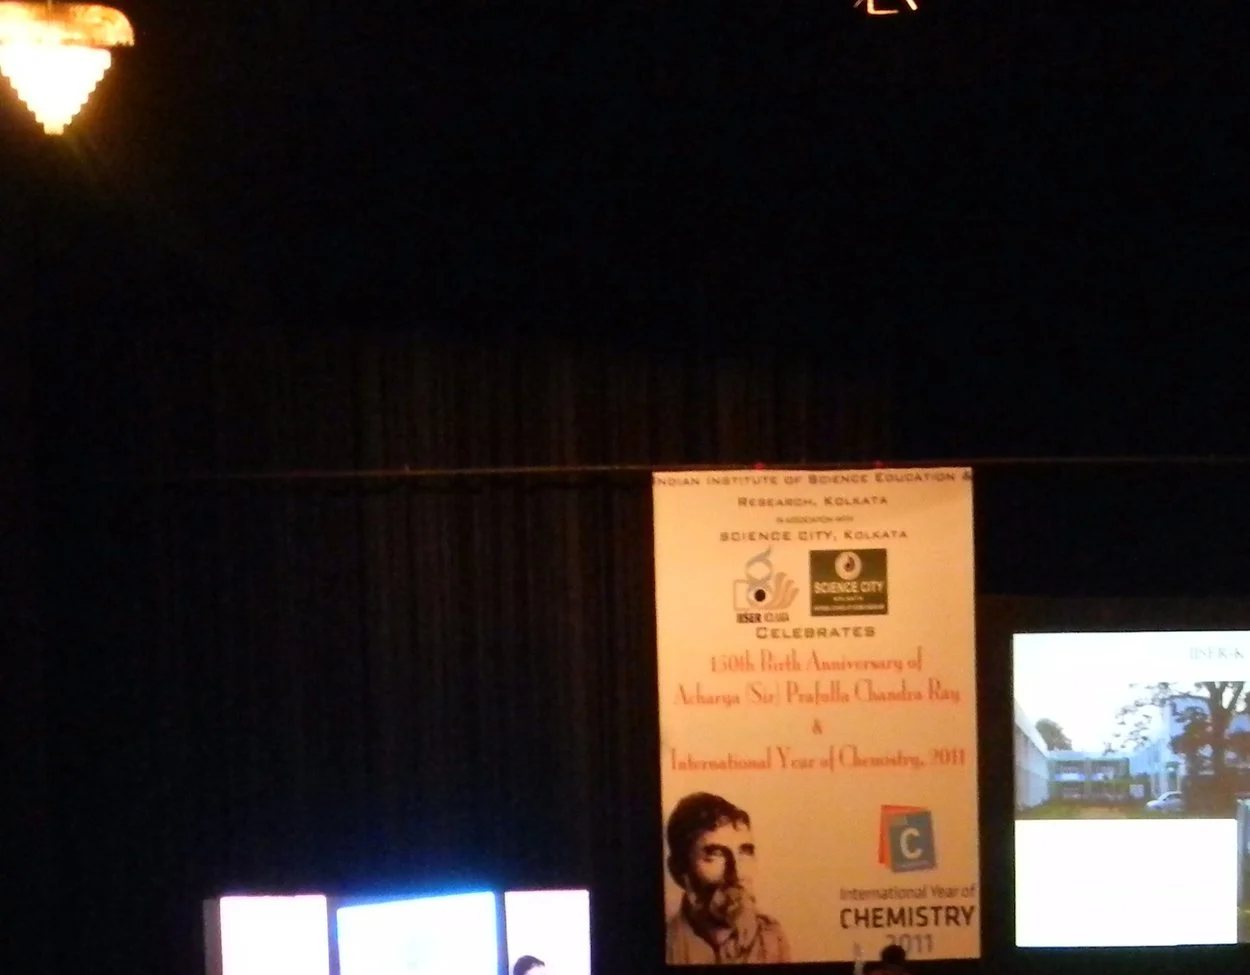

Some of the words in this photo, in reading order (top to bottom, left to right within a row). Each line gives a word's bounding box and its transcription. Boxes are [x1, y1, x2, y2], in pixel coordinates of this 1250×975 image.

[720, 531, 791, 541] SCIENCE
[843, 529, 908, 540] KOLKATA
[814, 581, 859, 594] SCIENCE
[860, 581, 884, 593] CITY
[755, 626, 876, 639] CELEBRATES
[711, 648, 755, 672] 150th
[760, 648, 802, 672] Birth
[805, 648, 904, 673] Anniversary
[907, 646, 923, 672] of
[673, 682, 740, 708] Acharya
[786, 680, 849, 705] Prafulla
[854, 678, 923, 702] Chandra
[928, 676, 962, 704] Ray
[811, 718, 823, 735] &
[671, 746, 773, 771] International
[776, 745, 815, 770] Year
[819, 744, 834, 773] of
[928, 748, 966, 766] 2011
[900, 827, 924, 860] C
[840, 885, 927, 900] International
[931, 884, 960, 899] Year
[962, 883, 976, 898] of
[840, 905, 976, 929] CHEMISTRY
